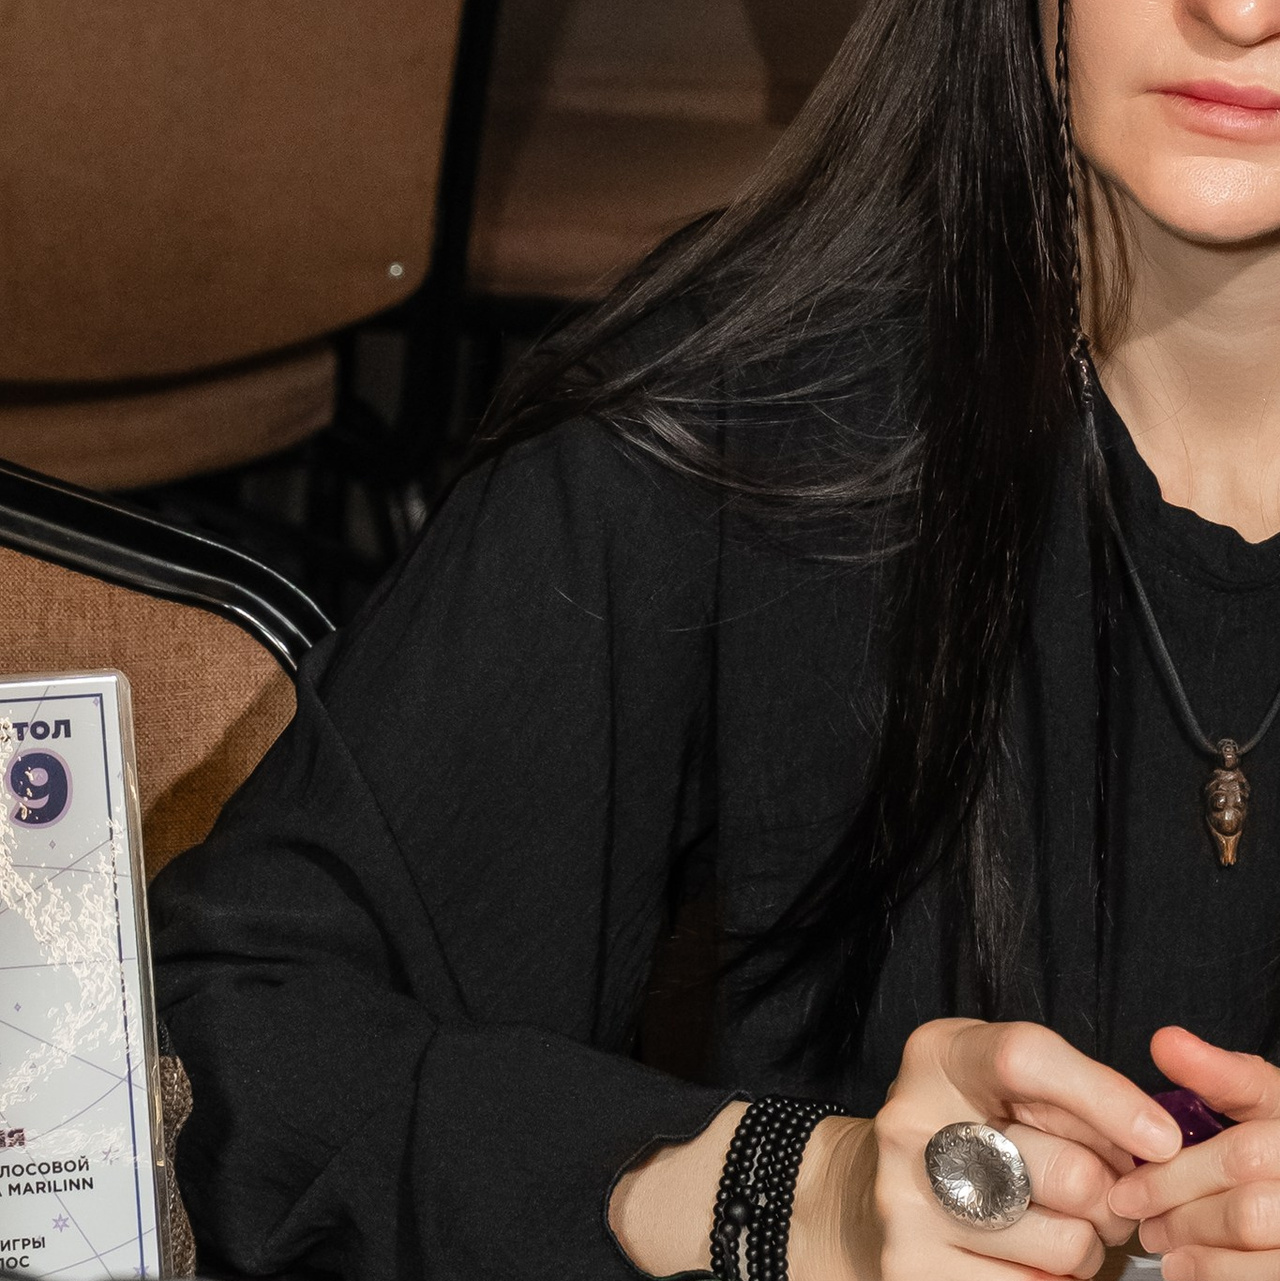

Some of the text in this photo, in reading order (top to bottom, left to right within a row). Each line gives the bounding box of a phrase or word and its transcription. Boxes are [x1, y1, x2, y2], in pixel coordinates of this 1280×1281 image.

[6, 749, 72, 828] 9
[0, 1155, 90, 1178] ЛОСОВОЙ
[8, 1177, 94, 1197] MARILINN
[0, 1237, 46, 1253] ИГРЫ
